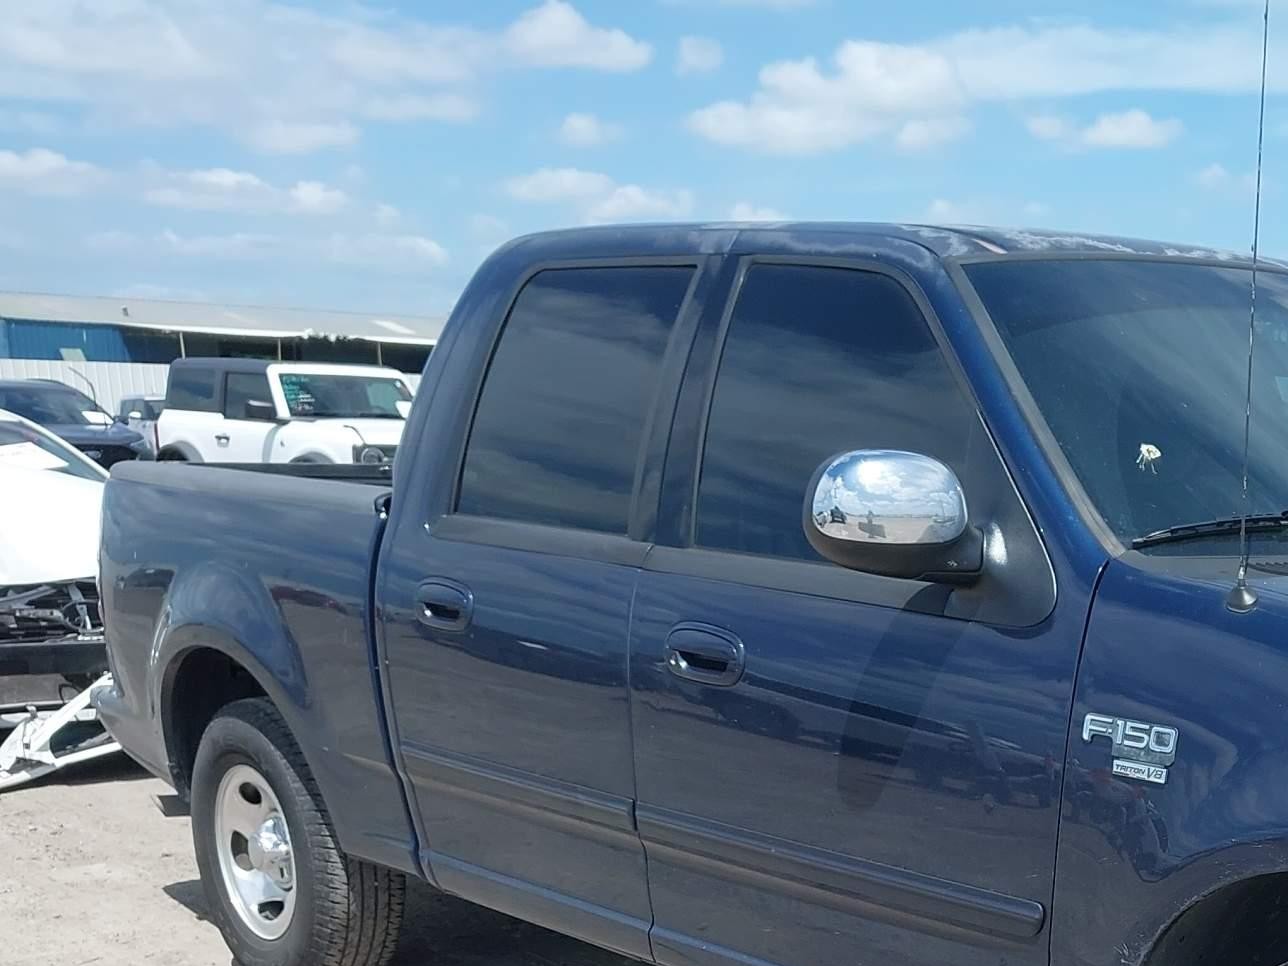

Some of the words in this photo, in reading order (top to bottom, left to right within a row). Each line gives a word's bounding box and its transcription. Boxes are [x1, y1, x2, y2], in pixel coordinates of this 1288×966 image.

[1082, 713, 1177, 753] F-150
[1115, 764, 1145, 774] TRITON
[1145, 767, 1164, 780] V8
